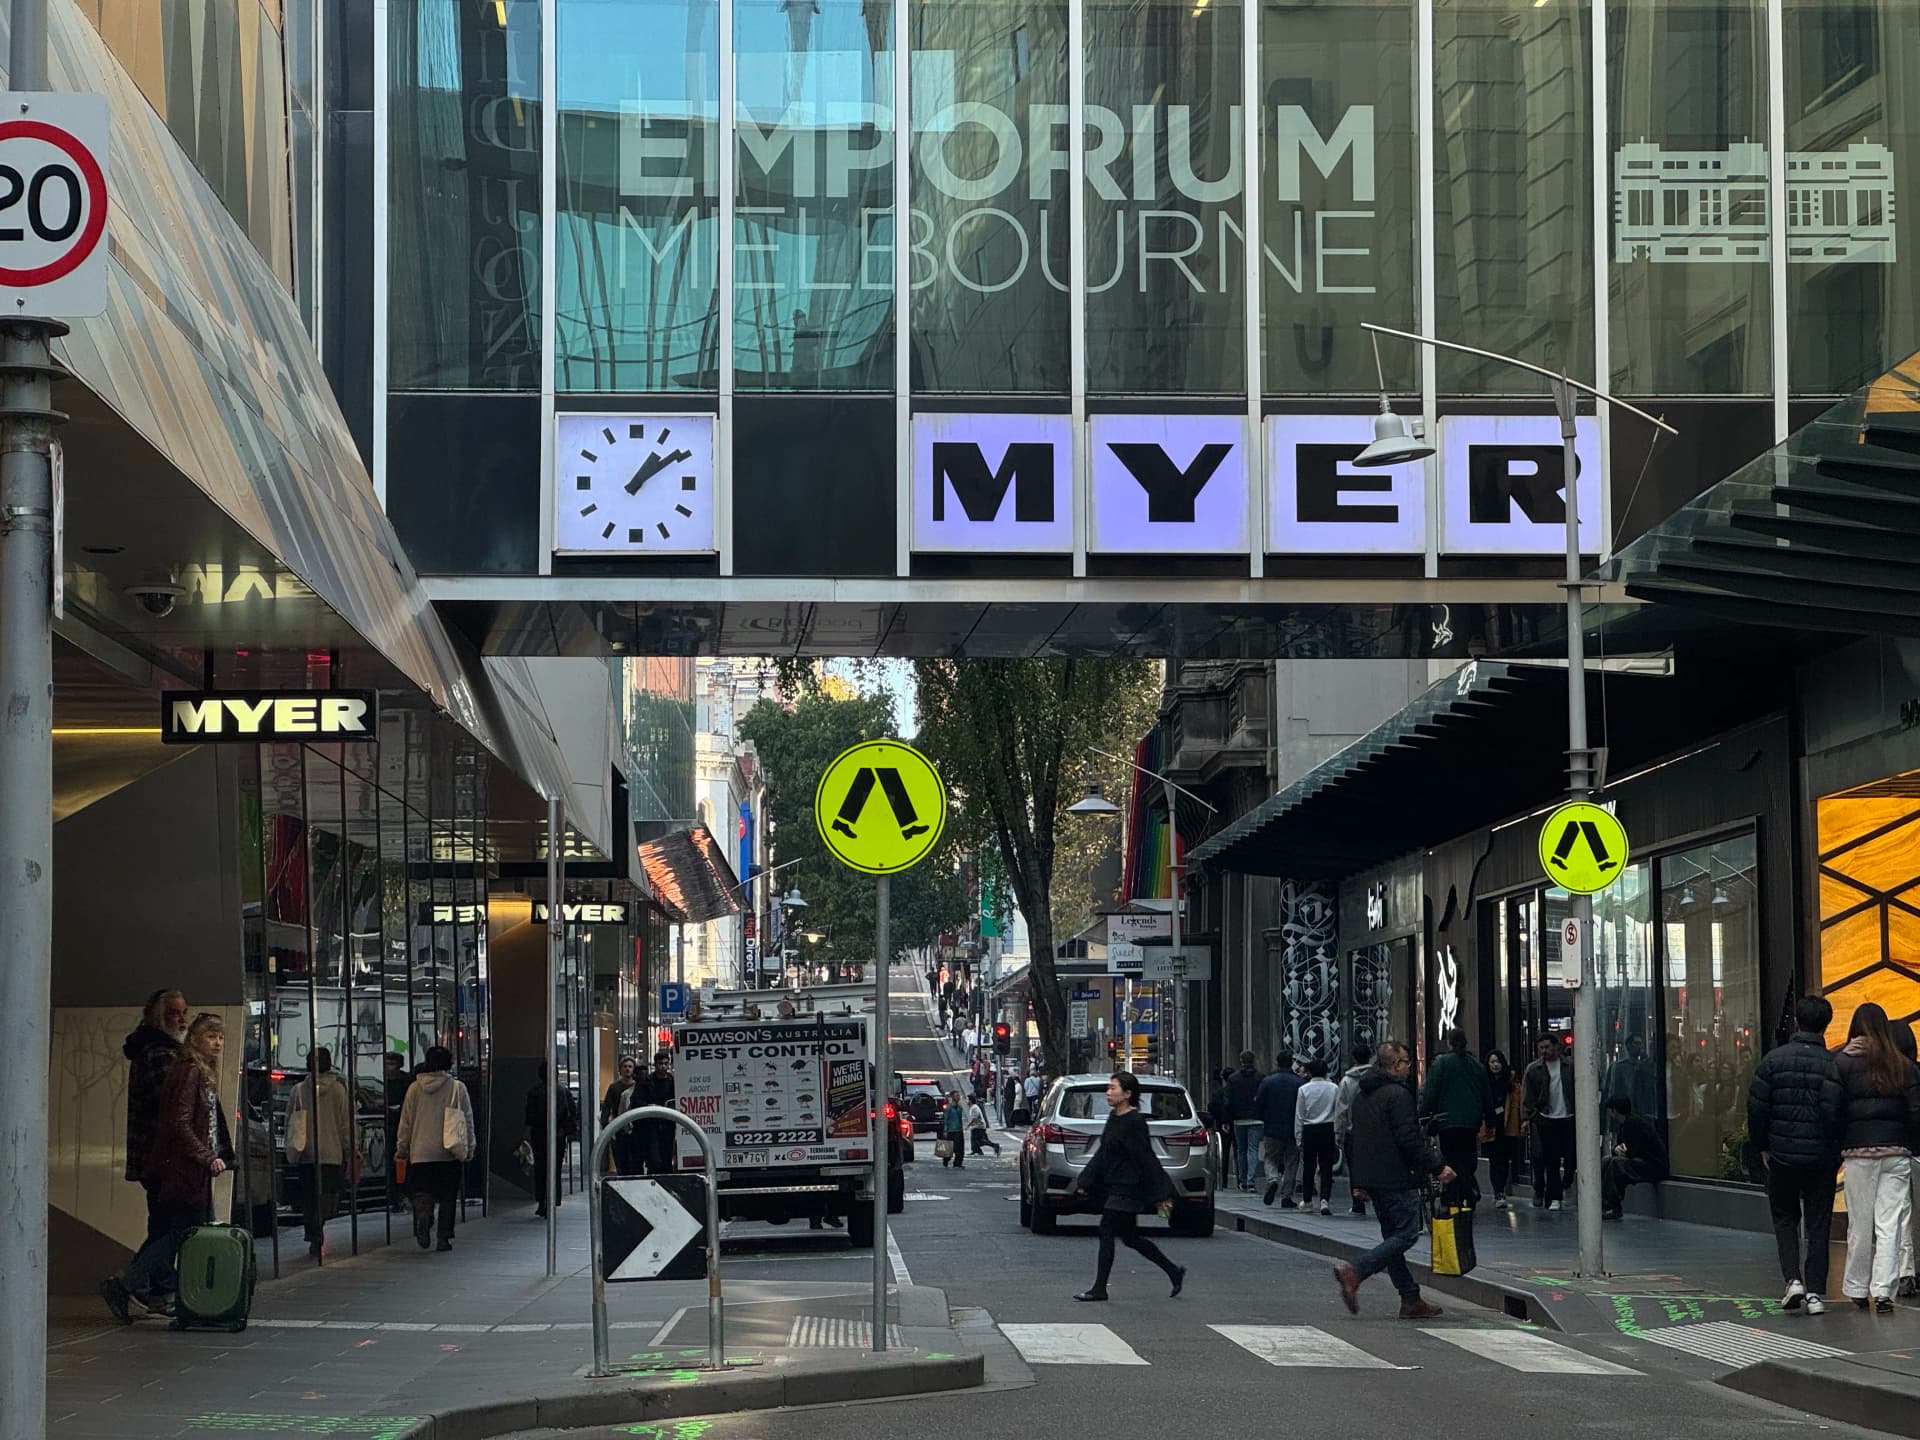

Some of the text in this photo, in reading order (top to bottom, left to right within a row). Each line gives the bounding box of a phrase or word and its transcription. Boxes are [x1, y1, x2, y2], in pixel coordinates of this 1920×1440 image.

[618, 100, 1376, 203] EMPORIUM
[619, 206, 1377, 294] MELBOURNE
[932, 442, 1583, 524] MYER
[171, 698, 367, 733] MYER
[535, 904, 625, 922] MYER
[1120, 915, 1157, 928] Legends
[666, 989, 678, 1009] P
[686, 1029, 771, 1045] DAWSON'S
[685, 1047, 741, 1060] PEST
[832, 1061, 862, 1077] WE'RE
[832, 1071, 863, 1088] HIRING
[679, 1095, 722, 1114] SMART
[734, 1131, 817, 1145] 9222 2222
